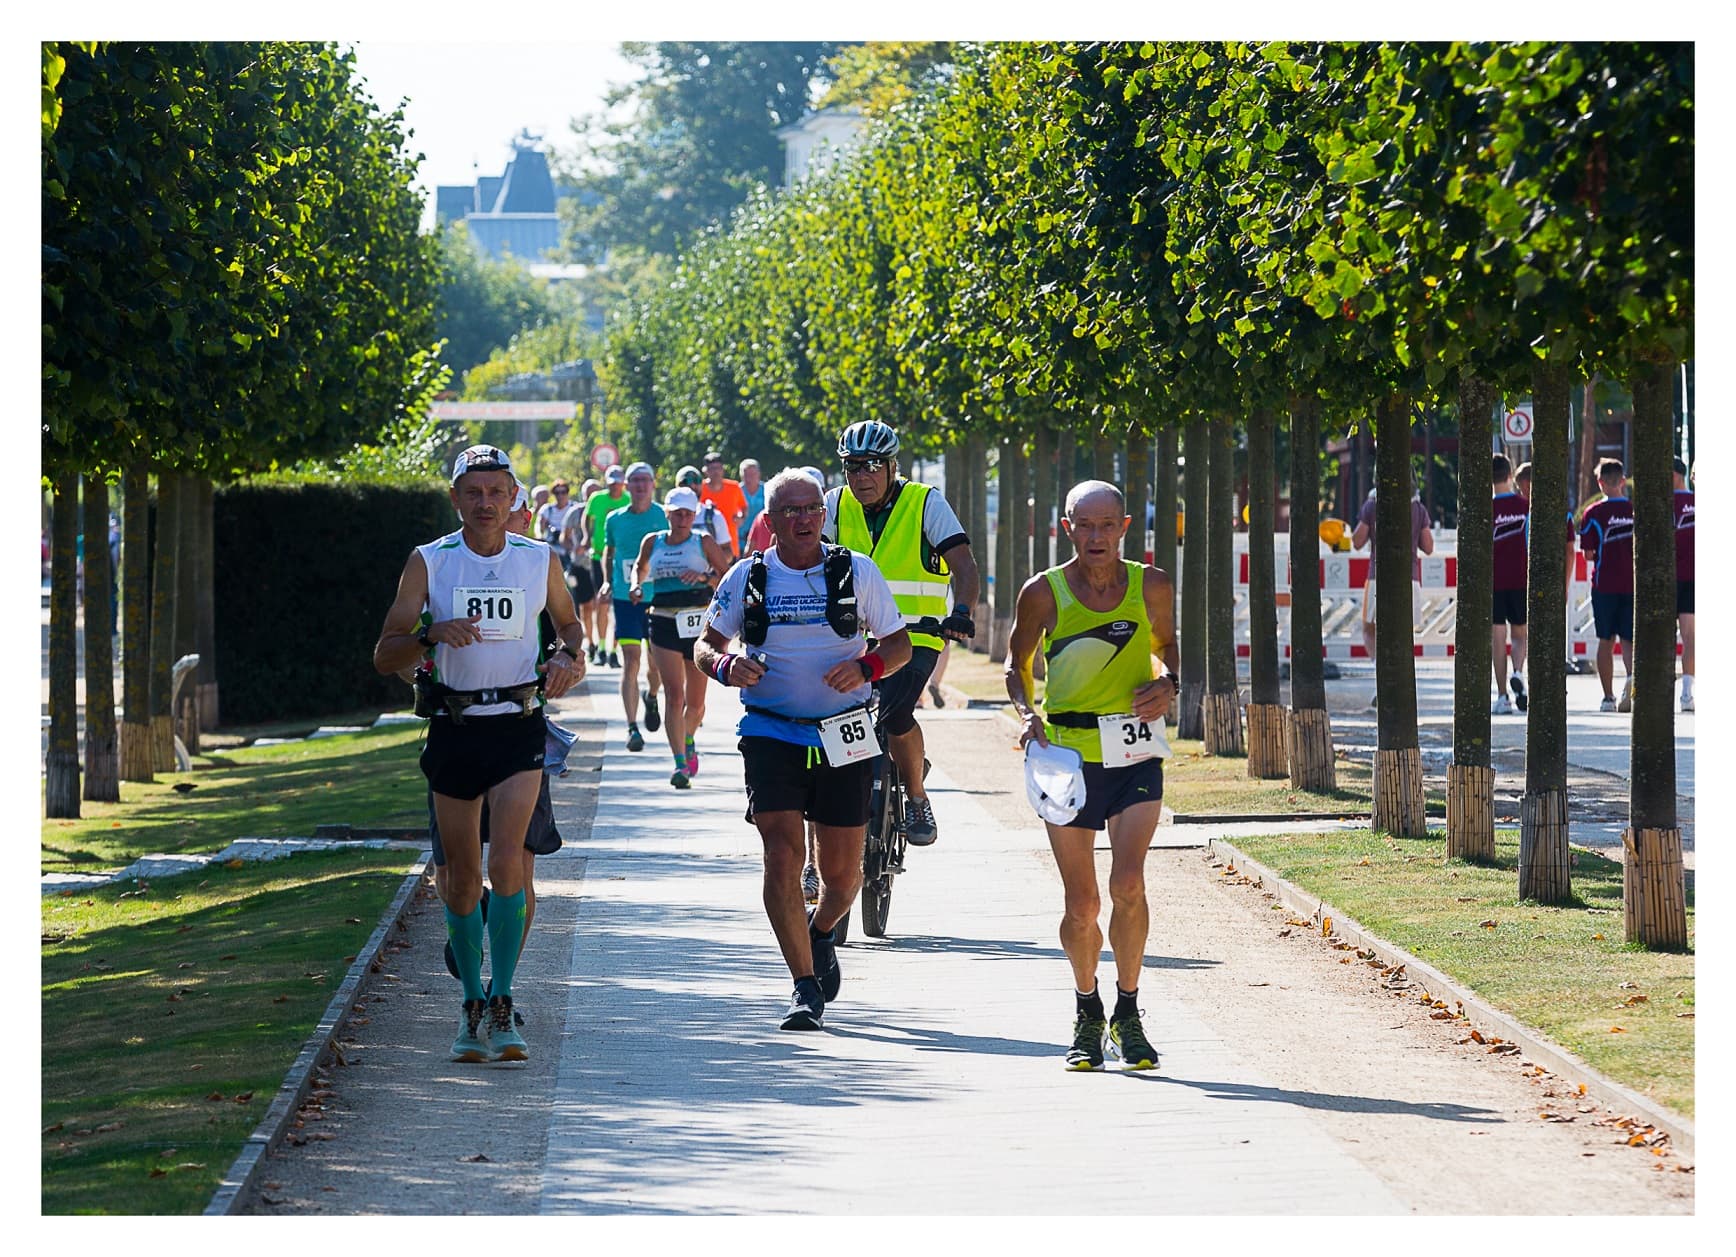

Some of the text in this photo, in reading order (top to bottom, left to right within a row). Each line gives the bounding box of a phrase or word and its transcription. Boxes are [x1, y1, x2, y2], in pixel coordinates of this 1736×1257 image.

[467, 597, 513, 620] 810
[687, 615, 702, 627] 87
[840, 719, 866, 744] 85
[1122, 722, 1152, 745] 34
